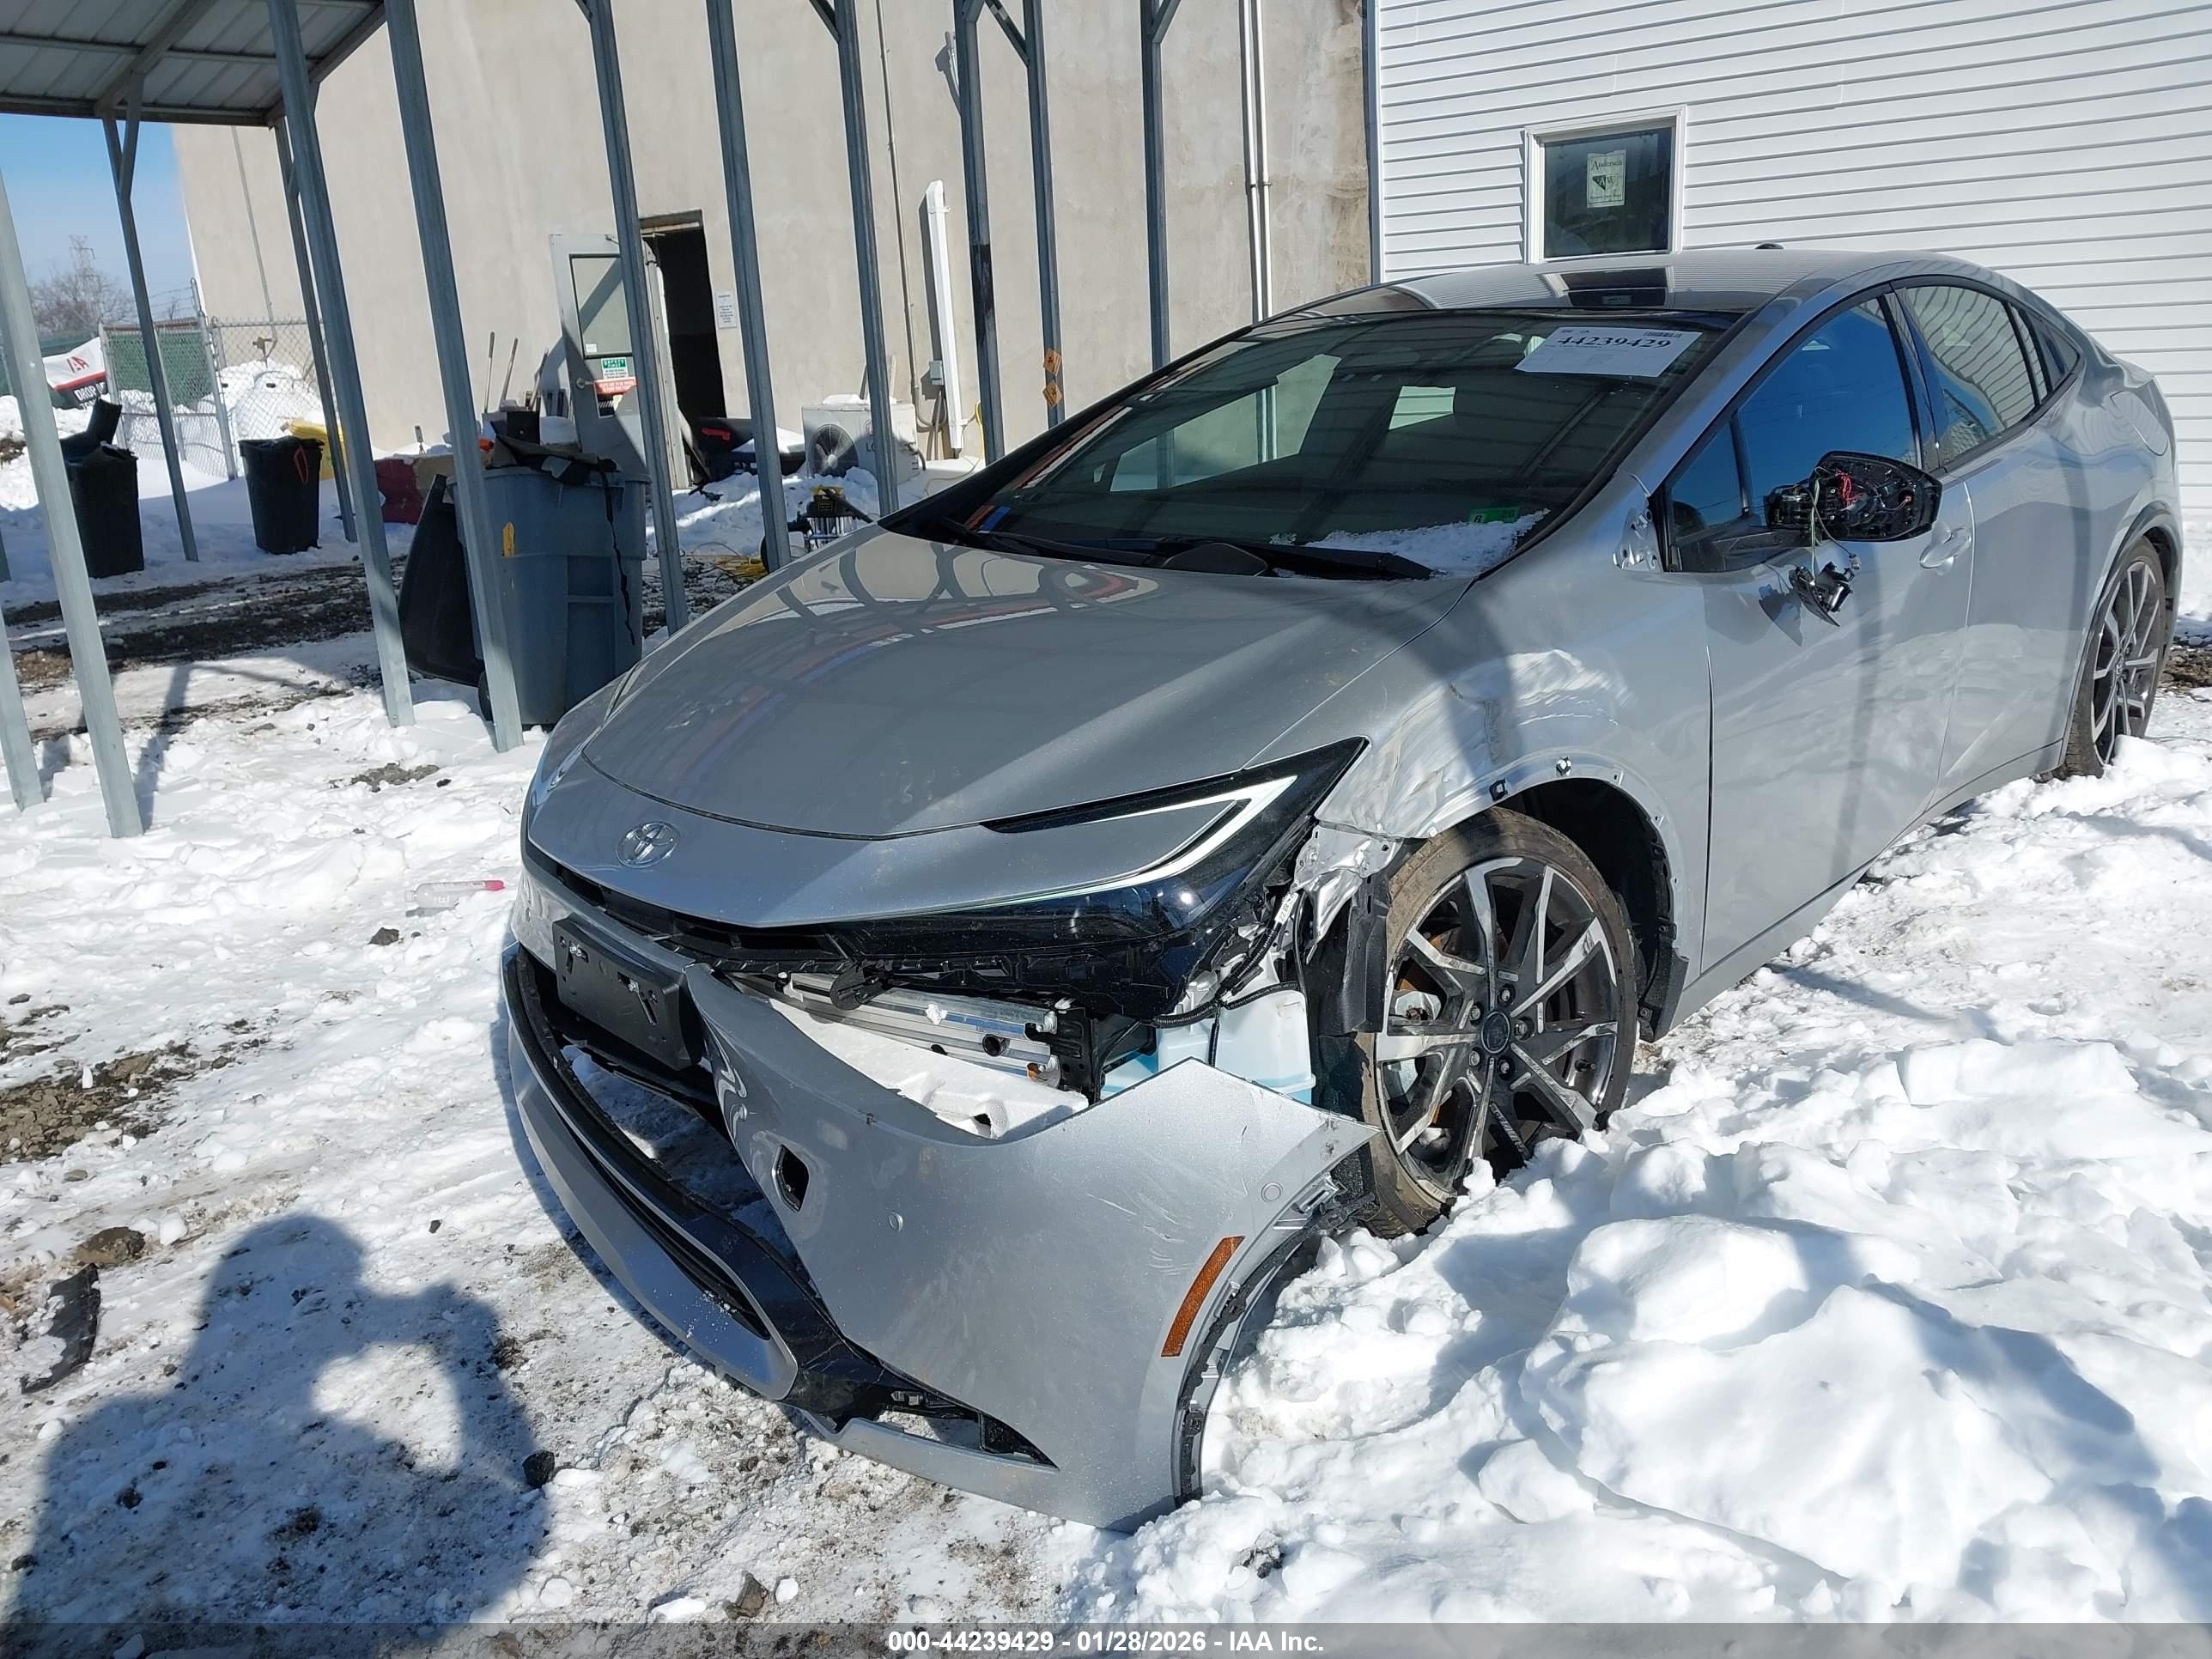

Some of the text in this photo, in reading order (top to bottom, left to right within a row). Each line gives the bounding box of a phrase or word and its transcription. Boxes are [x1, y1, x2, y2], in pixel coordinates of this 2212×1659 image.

[1591, 160, 1623, 170] Andersen
[1558, 336, 1672, 349] 44239429
[74, 385, 97, 402] DROP
